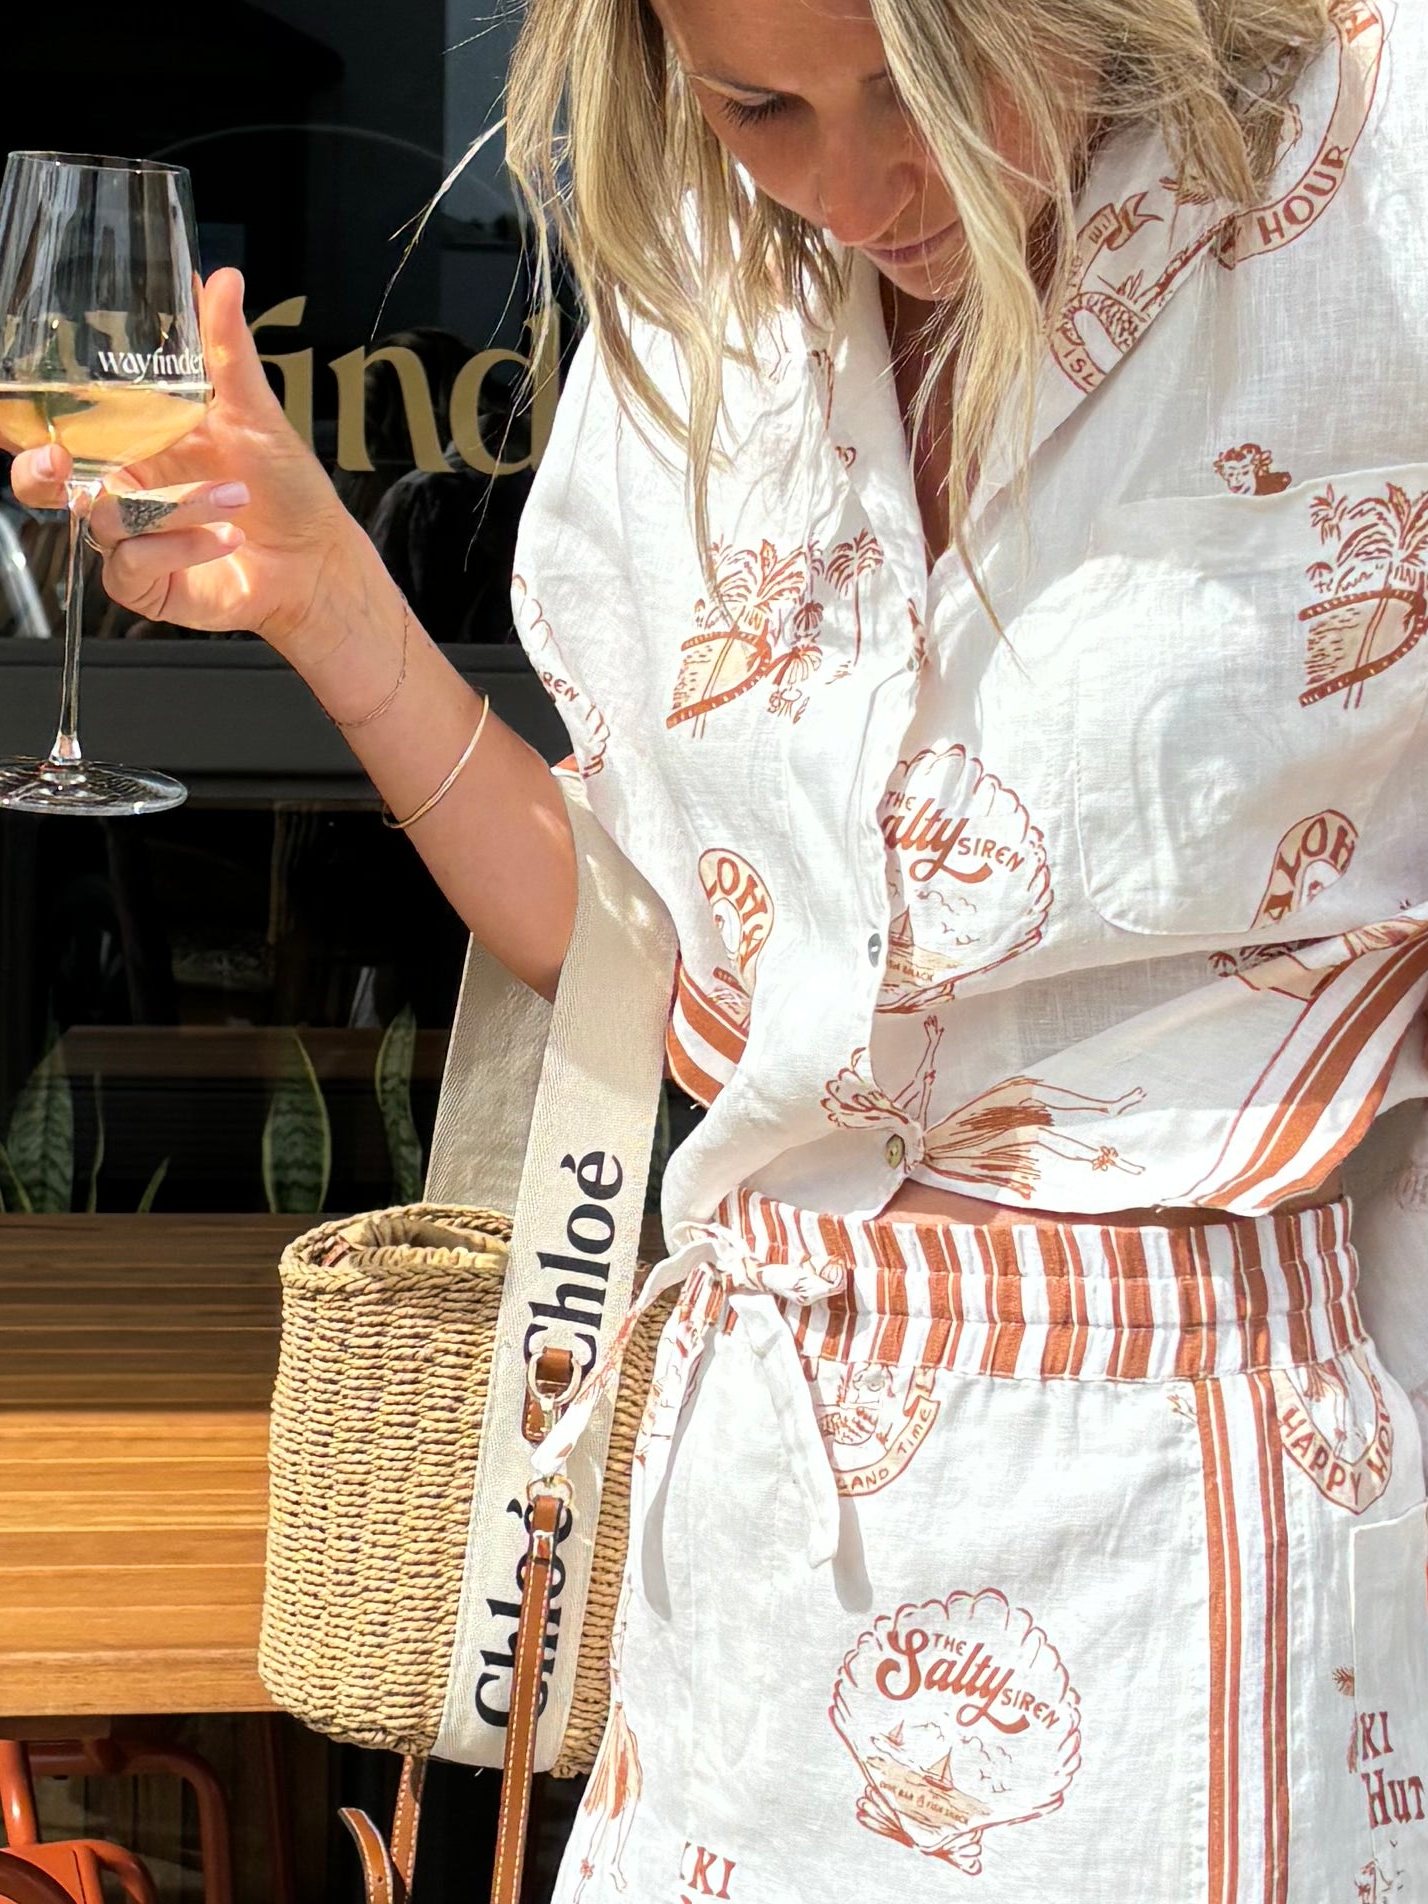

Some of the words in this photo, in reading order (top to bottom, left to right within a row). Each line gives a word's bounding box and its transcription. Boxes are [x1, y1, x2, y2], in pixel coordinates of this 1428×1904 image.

[1255, 143, 1350, 247] HOUR
[886, 790, 917, 812] THE
[957, 837, 1025, 873] SIREN
[707, 857, 768, 974] OHA
[897, 1408, 933, 1454] TIME
[1278, 1403, 1362, 1505] HAPPY
[932, 1632, 967, 1657] THE
[875, 1627, 1031, 1735] Salty
[1000, 1687, 1061, 1730] SIREN
[679, 1841, 737, 1900] KI
